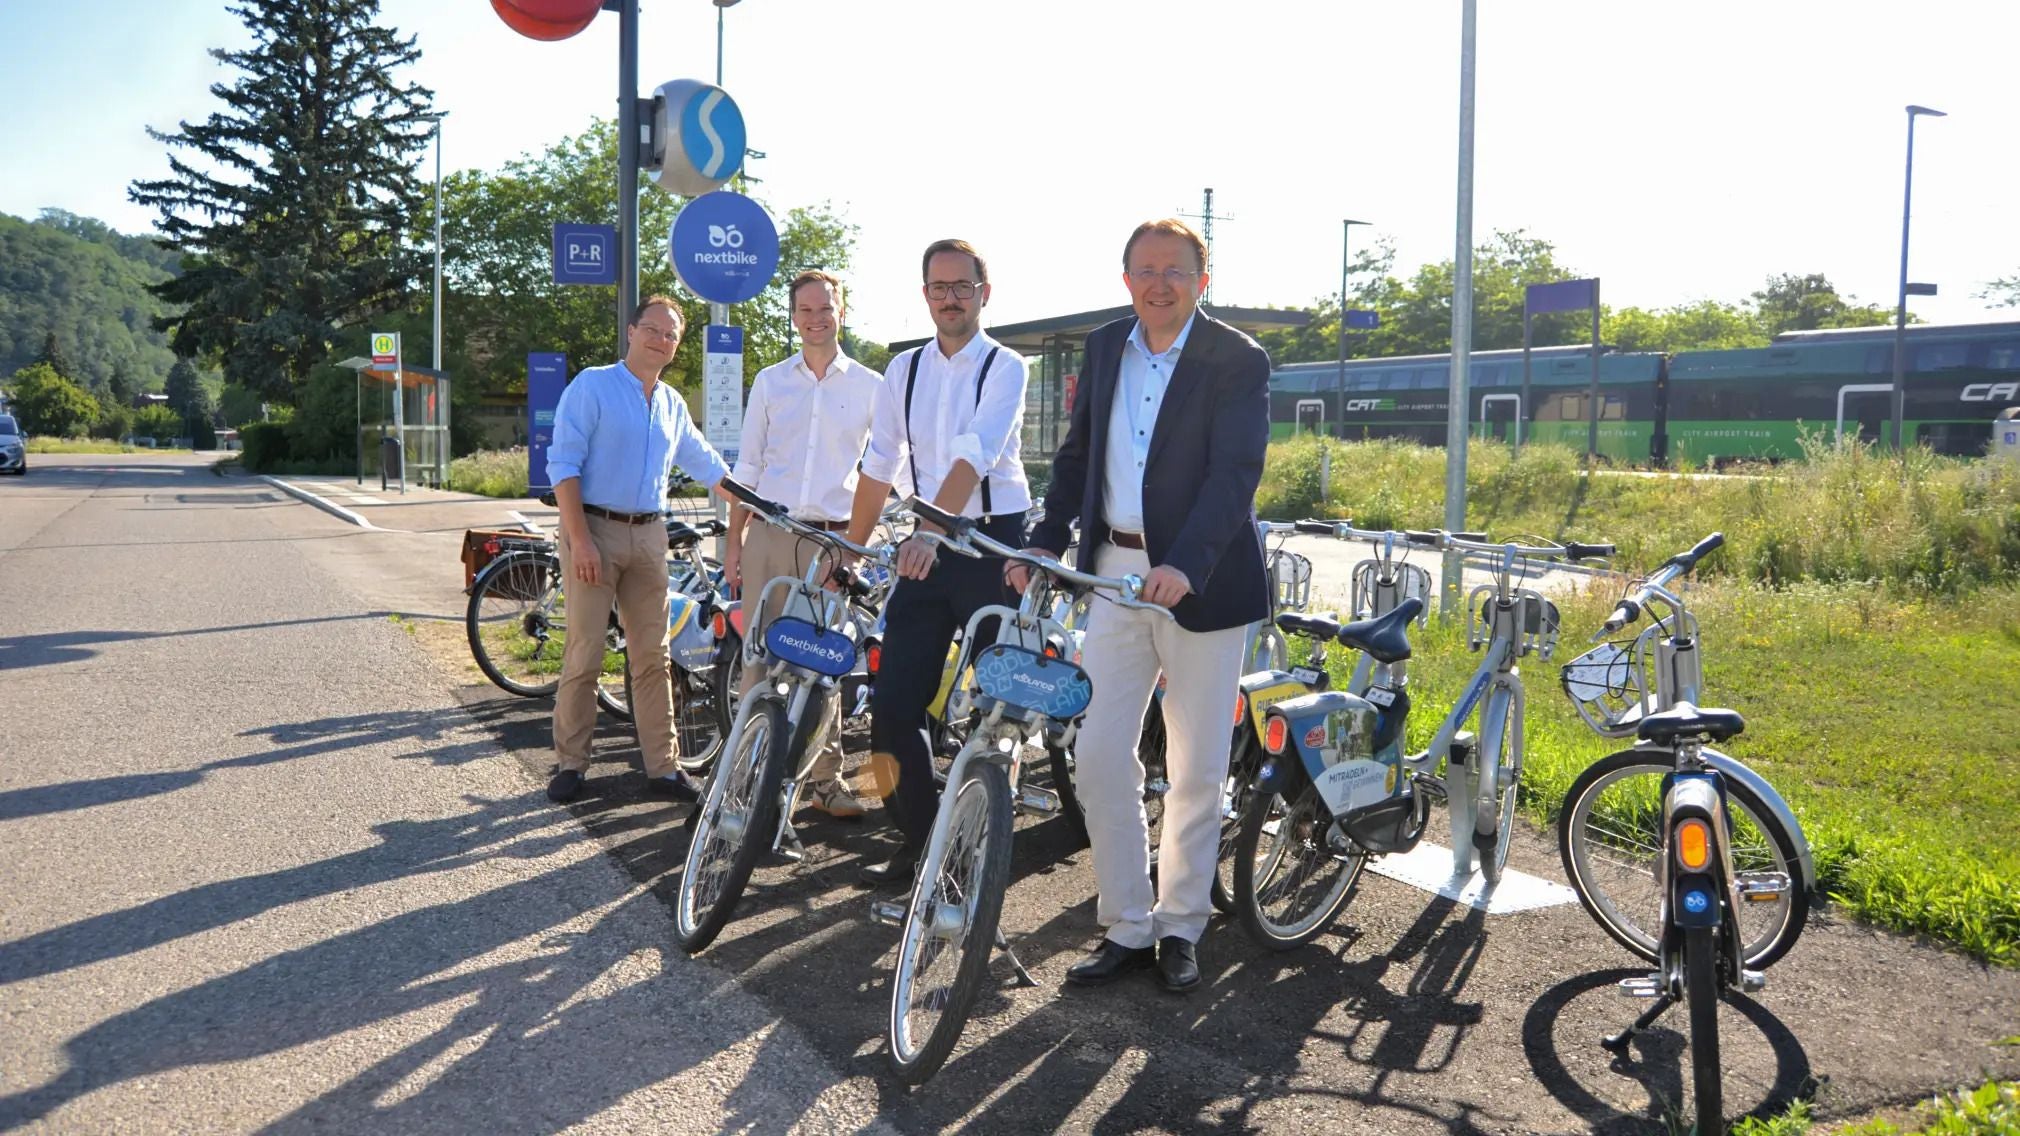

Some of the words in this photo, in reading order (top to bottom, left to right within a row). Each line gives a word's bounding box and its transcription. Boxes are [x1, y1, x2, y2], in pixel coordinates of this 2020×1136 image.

[569, 244, 601, 260] P+R
[694, 250, 758, 265] nextbike
[1960, 383, 2020, 401] CA
[1346, 399, 1381, 411] CAT
[778, 634, 827, 657] nextbike
